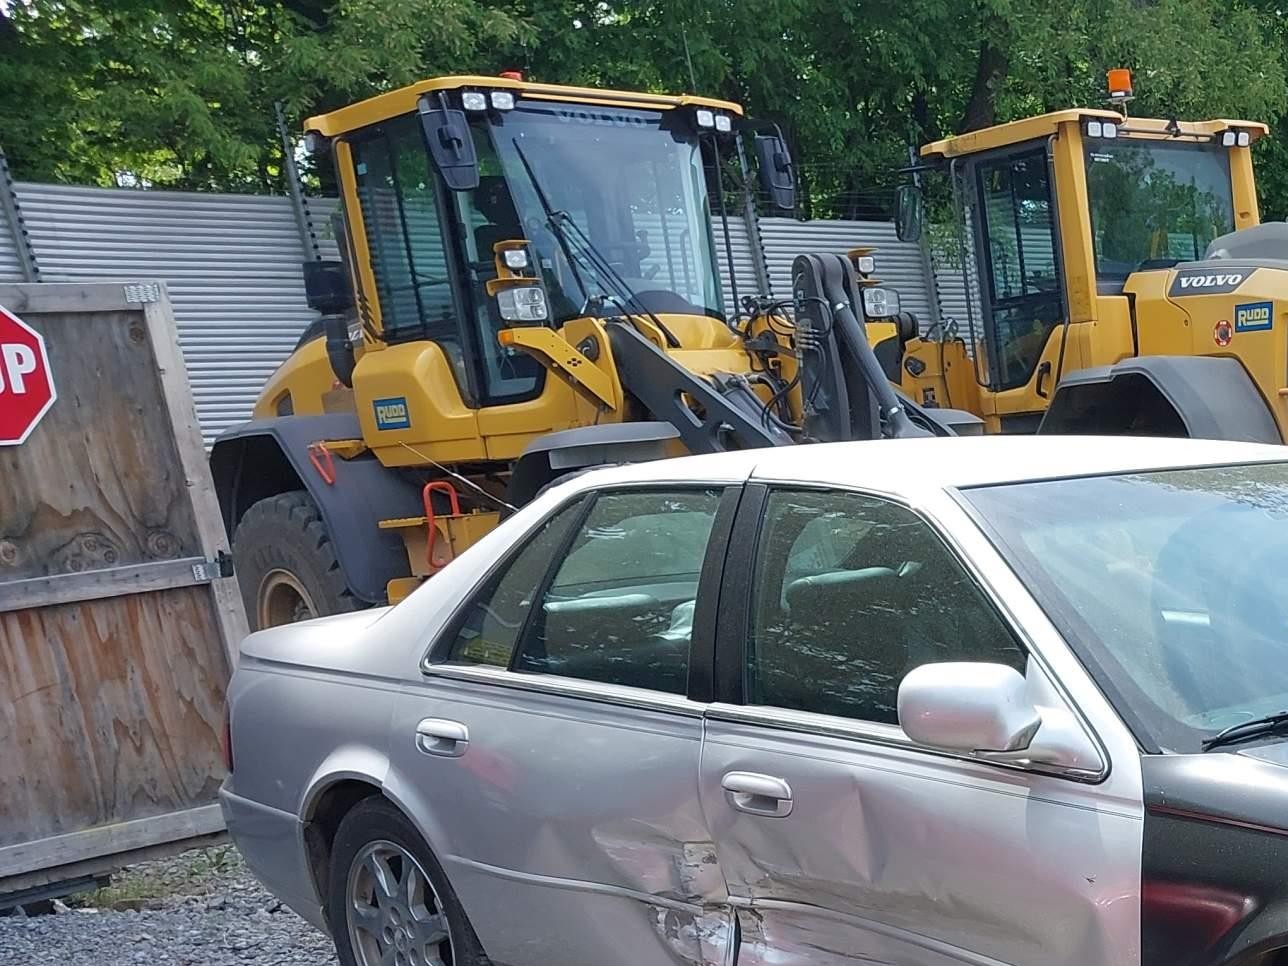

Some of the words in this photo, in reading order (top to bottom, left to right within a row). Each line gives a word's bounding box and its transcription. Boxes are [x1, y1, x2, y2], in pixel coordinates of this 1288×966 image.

[1180, 274, 1242, 288] VOLVO
[1238, 308, 1269, 327] RUDD
[0, 343, 36, 394] P
[376, 404, 407, 424] RUDD
